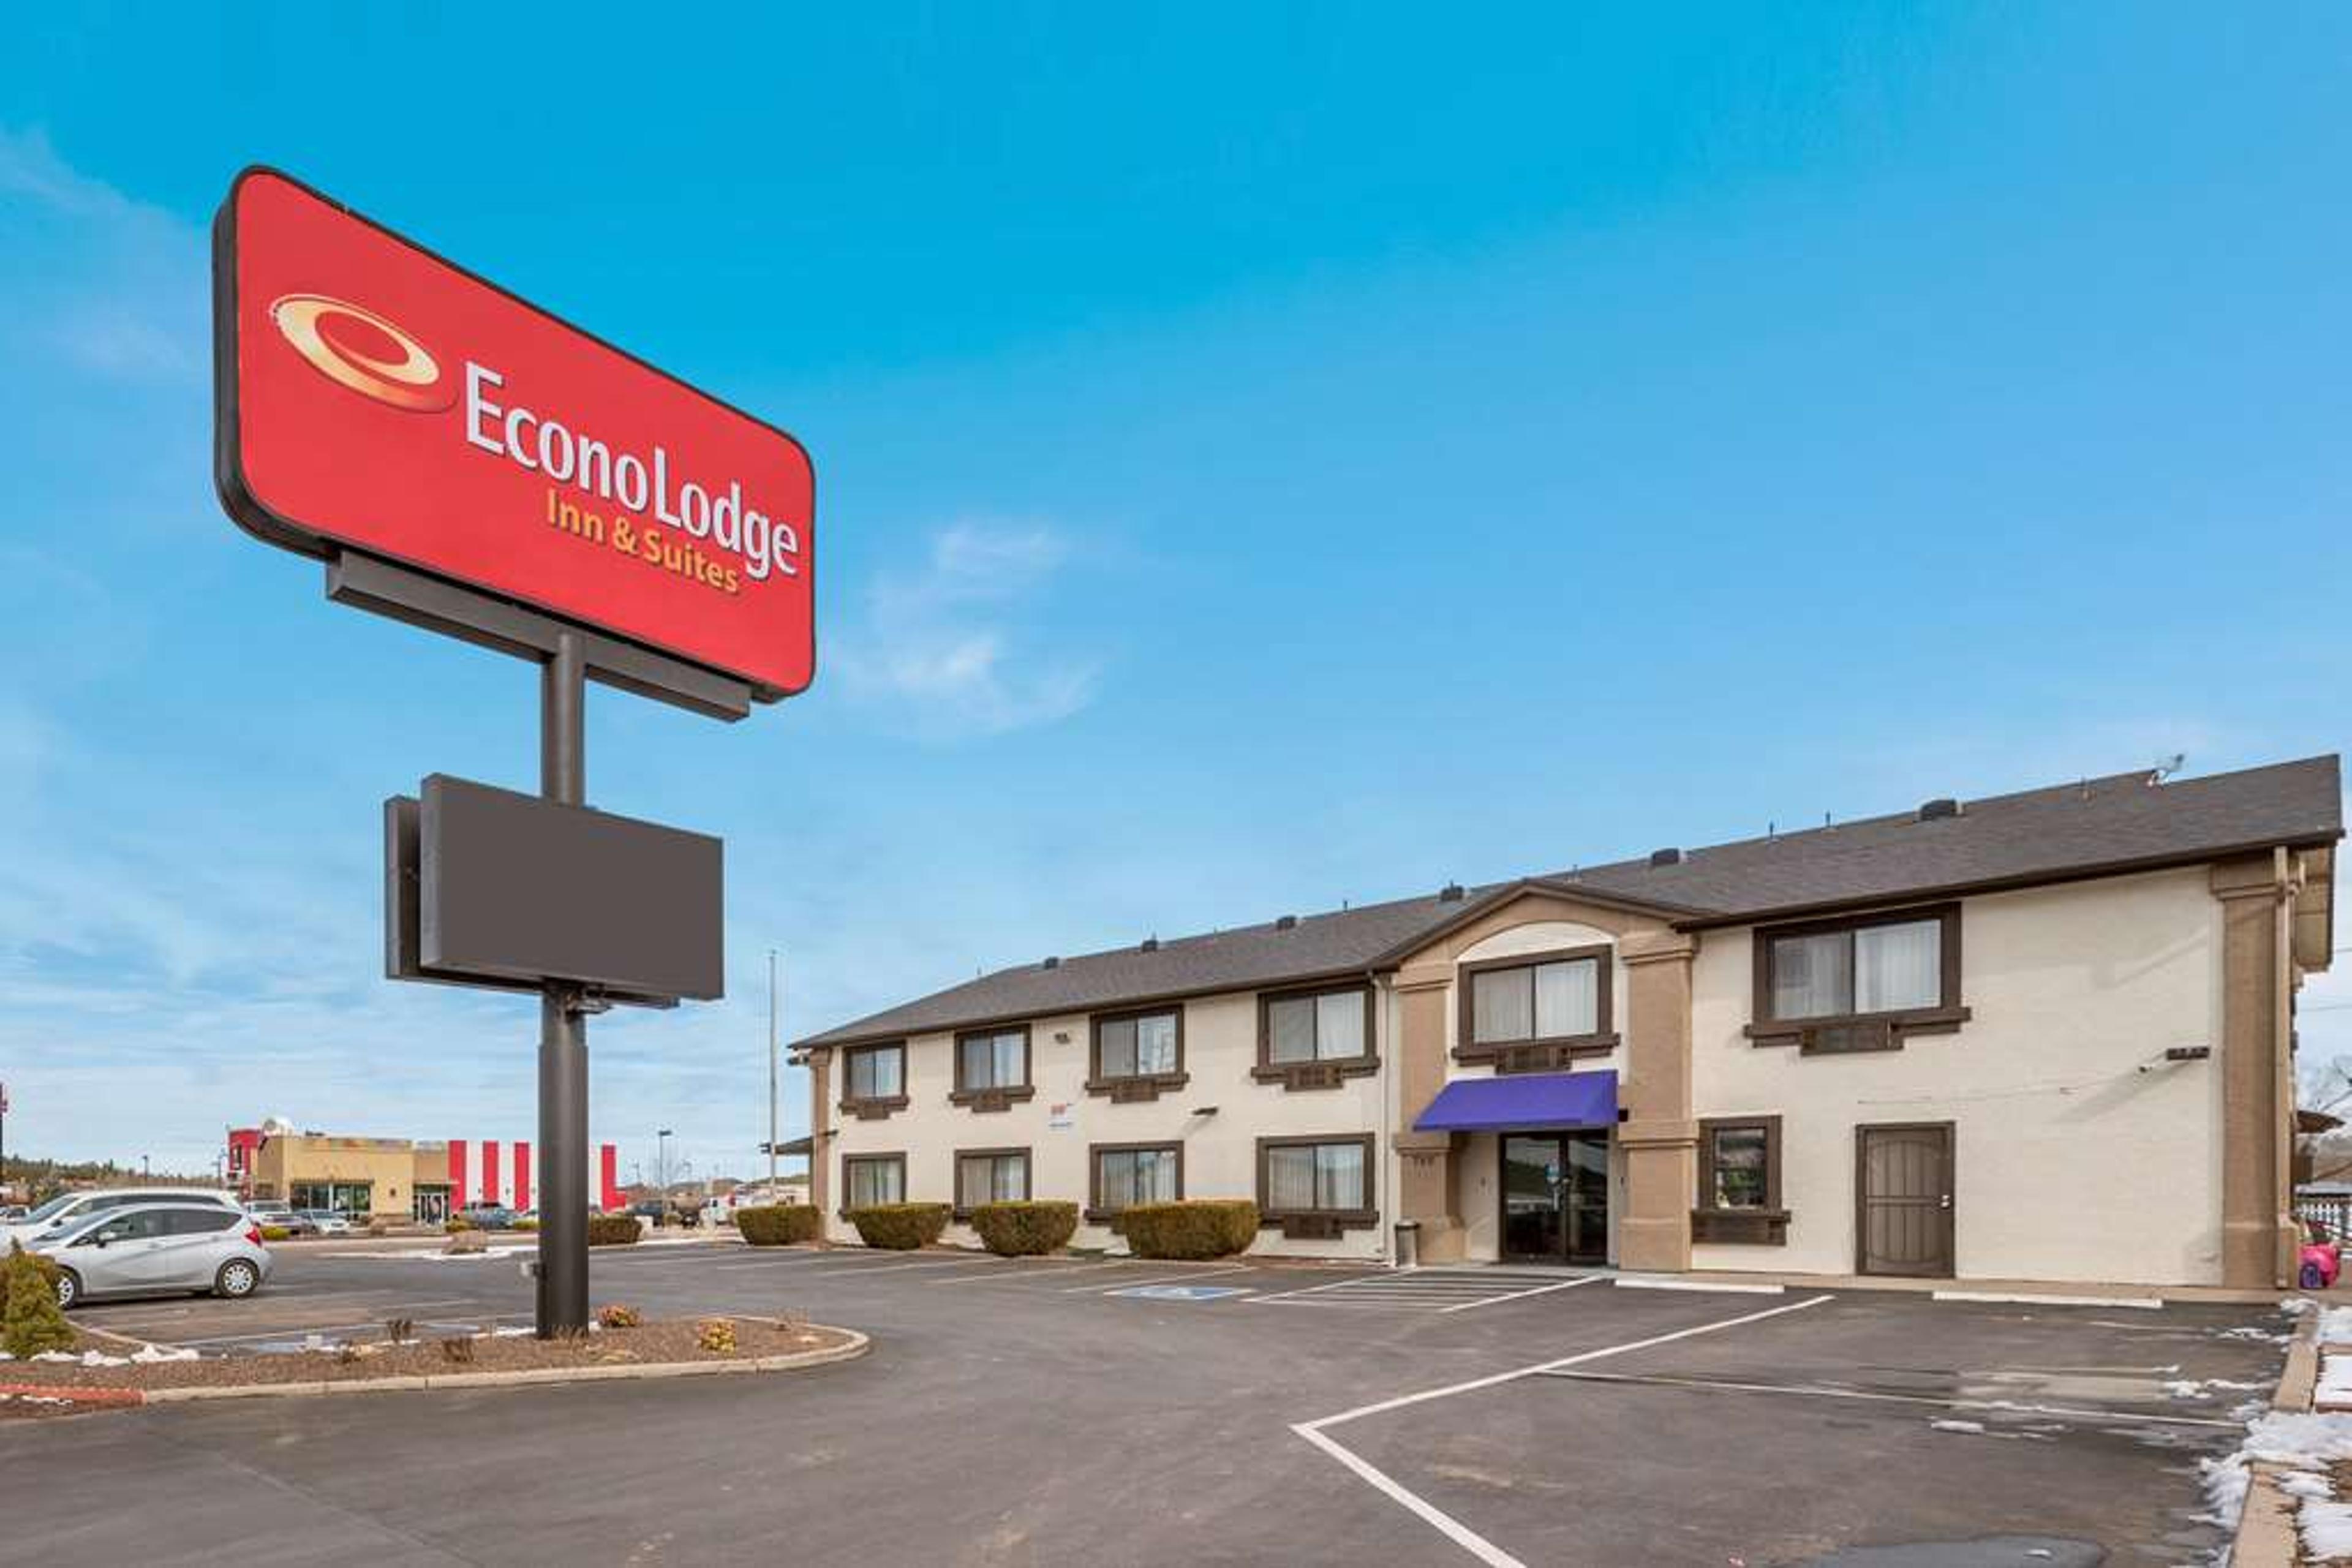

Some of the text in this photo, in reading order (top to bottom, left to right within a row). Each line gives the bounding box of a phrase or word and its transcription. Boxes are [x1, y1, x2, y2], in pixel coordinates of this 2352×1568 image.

[466, 361, 799, 578] EconoLodge
[546, 488, 739, 593] Inn & Suites
